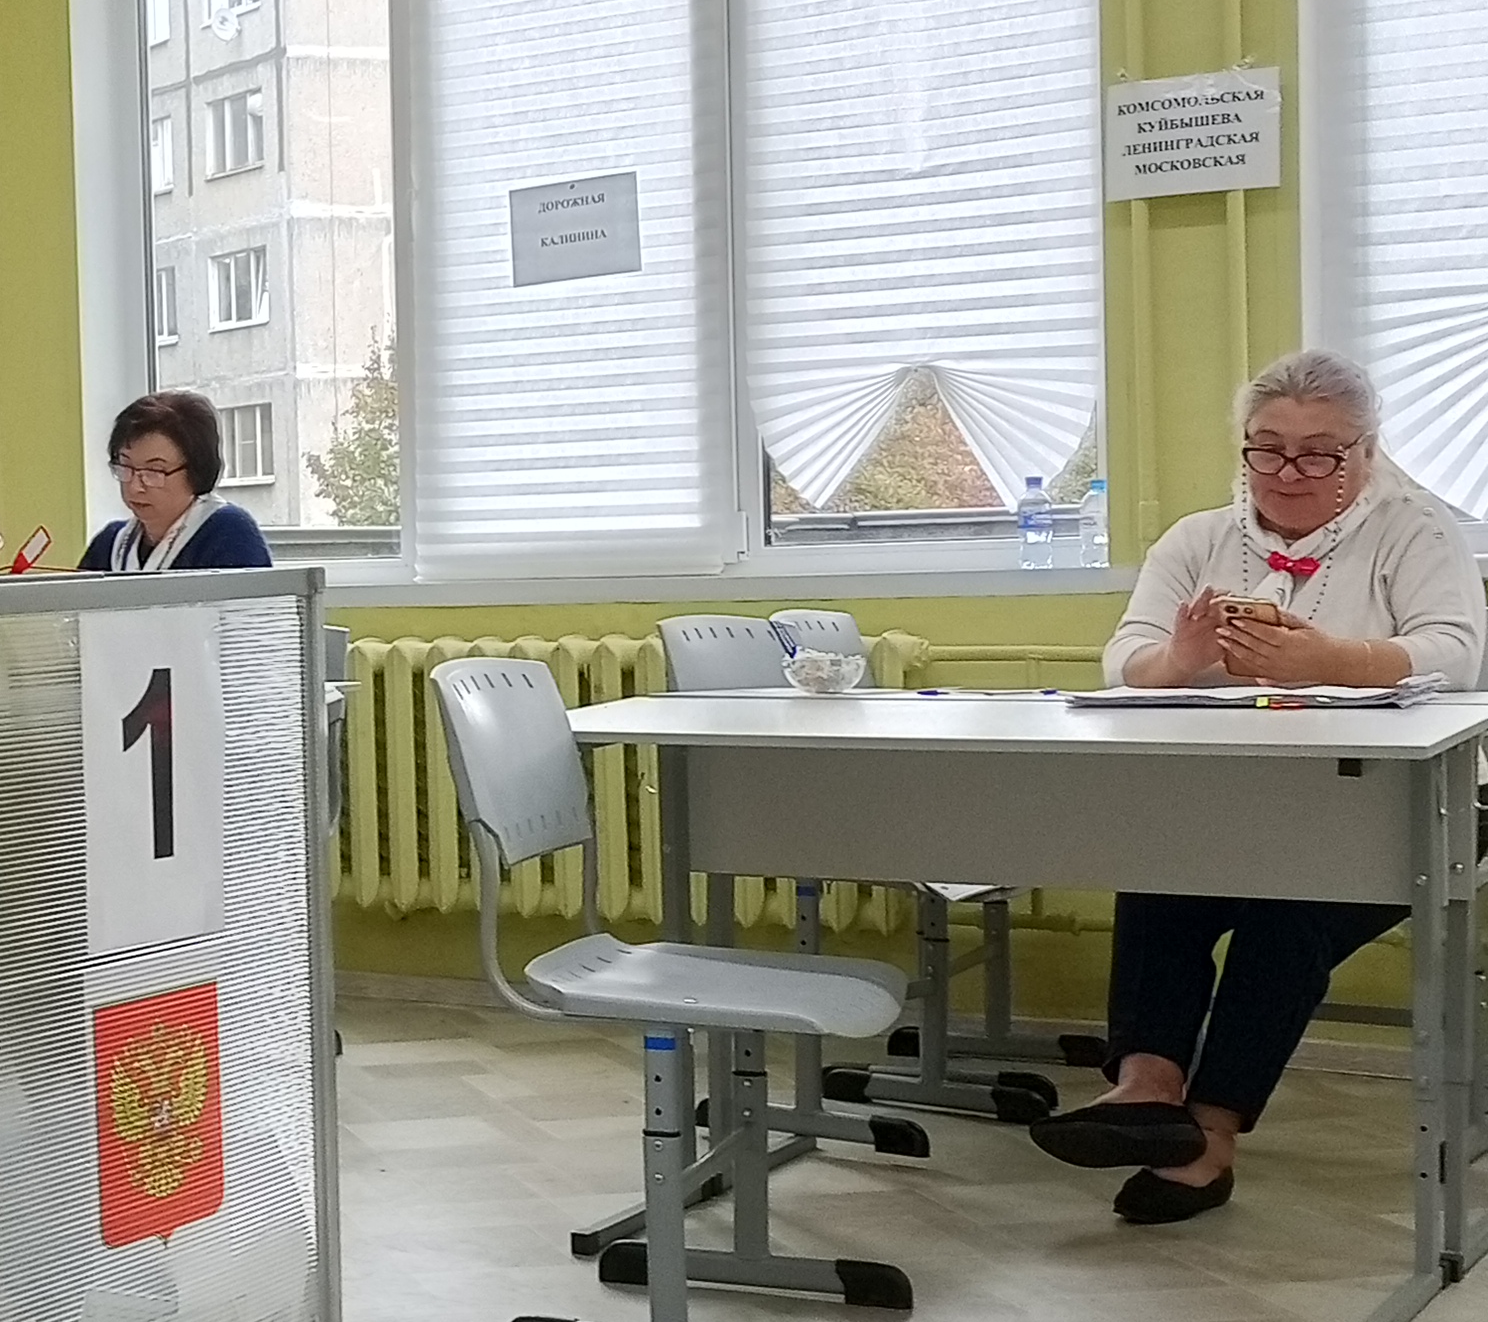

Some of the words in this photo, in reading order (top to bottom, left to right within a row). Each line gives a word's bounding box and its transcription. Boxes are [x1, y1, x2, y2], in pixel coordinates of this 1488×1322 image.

[1117, 89, 1265, 116] КОМСОМОЛЬСКАЯ
[1137, 112, 1242, 134] КУЙБЫШЕВА
[1122, 131, 1260, 157] ЛЕНИНГРАДСКАЯ
[1134, 153, 1246, 176] МОСКОВСКАЯ
[538, 192, 605, 214] ДОРОЖНАЯ
[540, 228, 607, 248] КАЛИНИНА
[122, 668, 174, 859] 1
